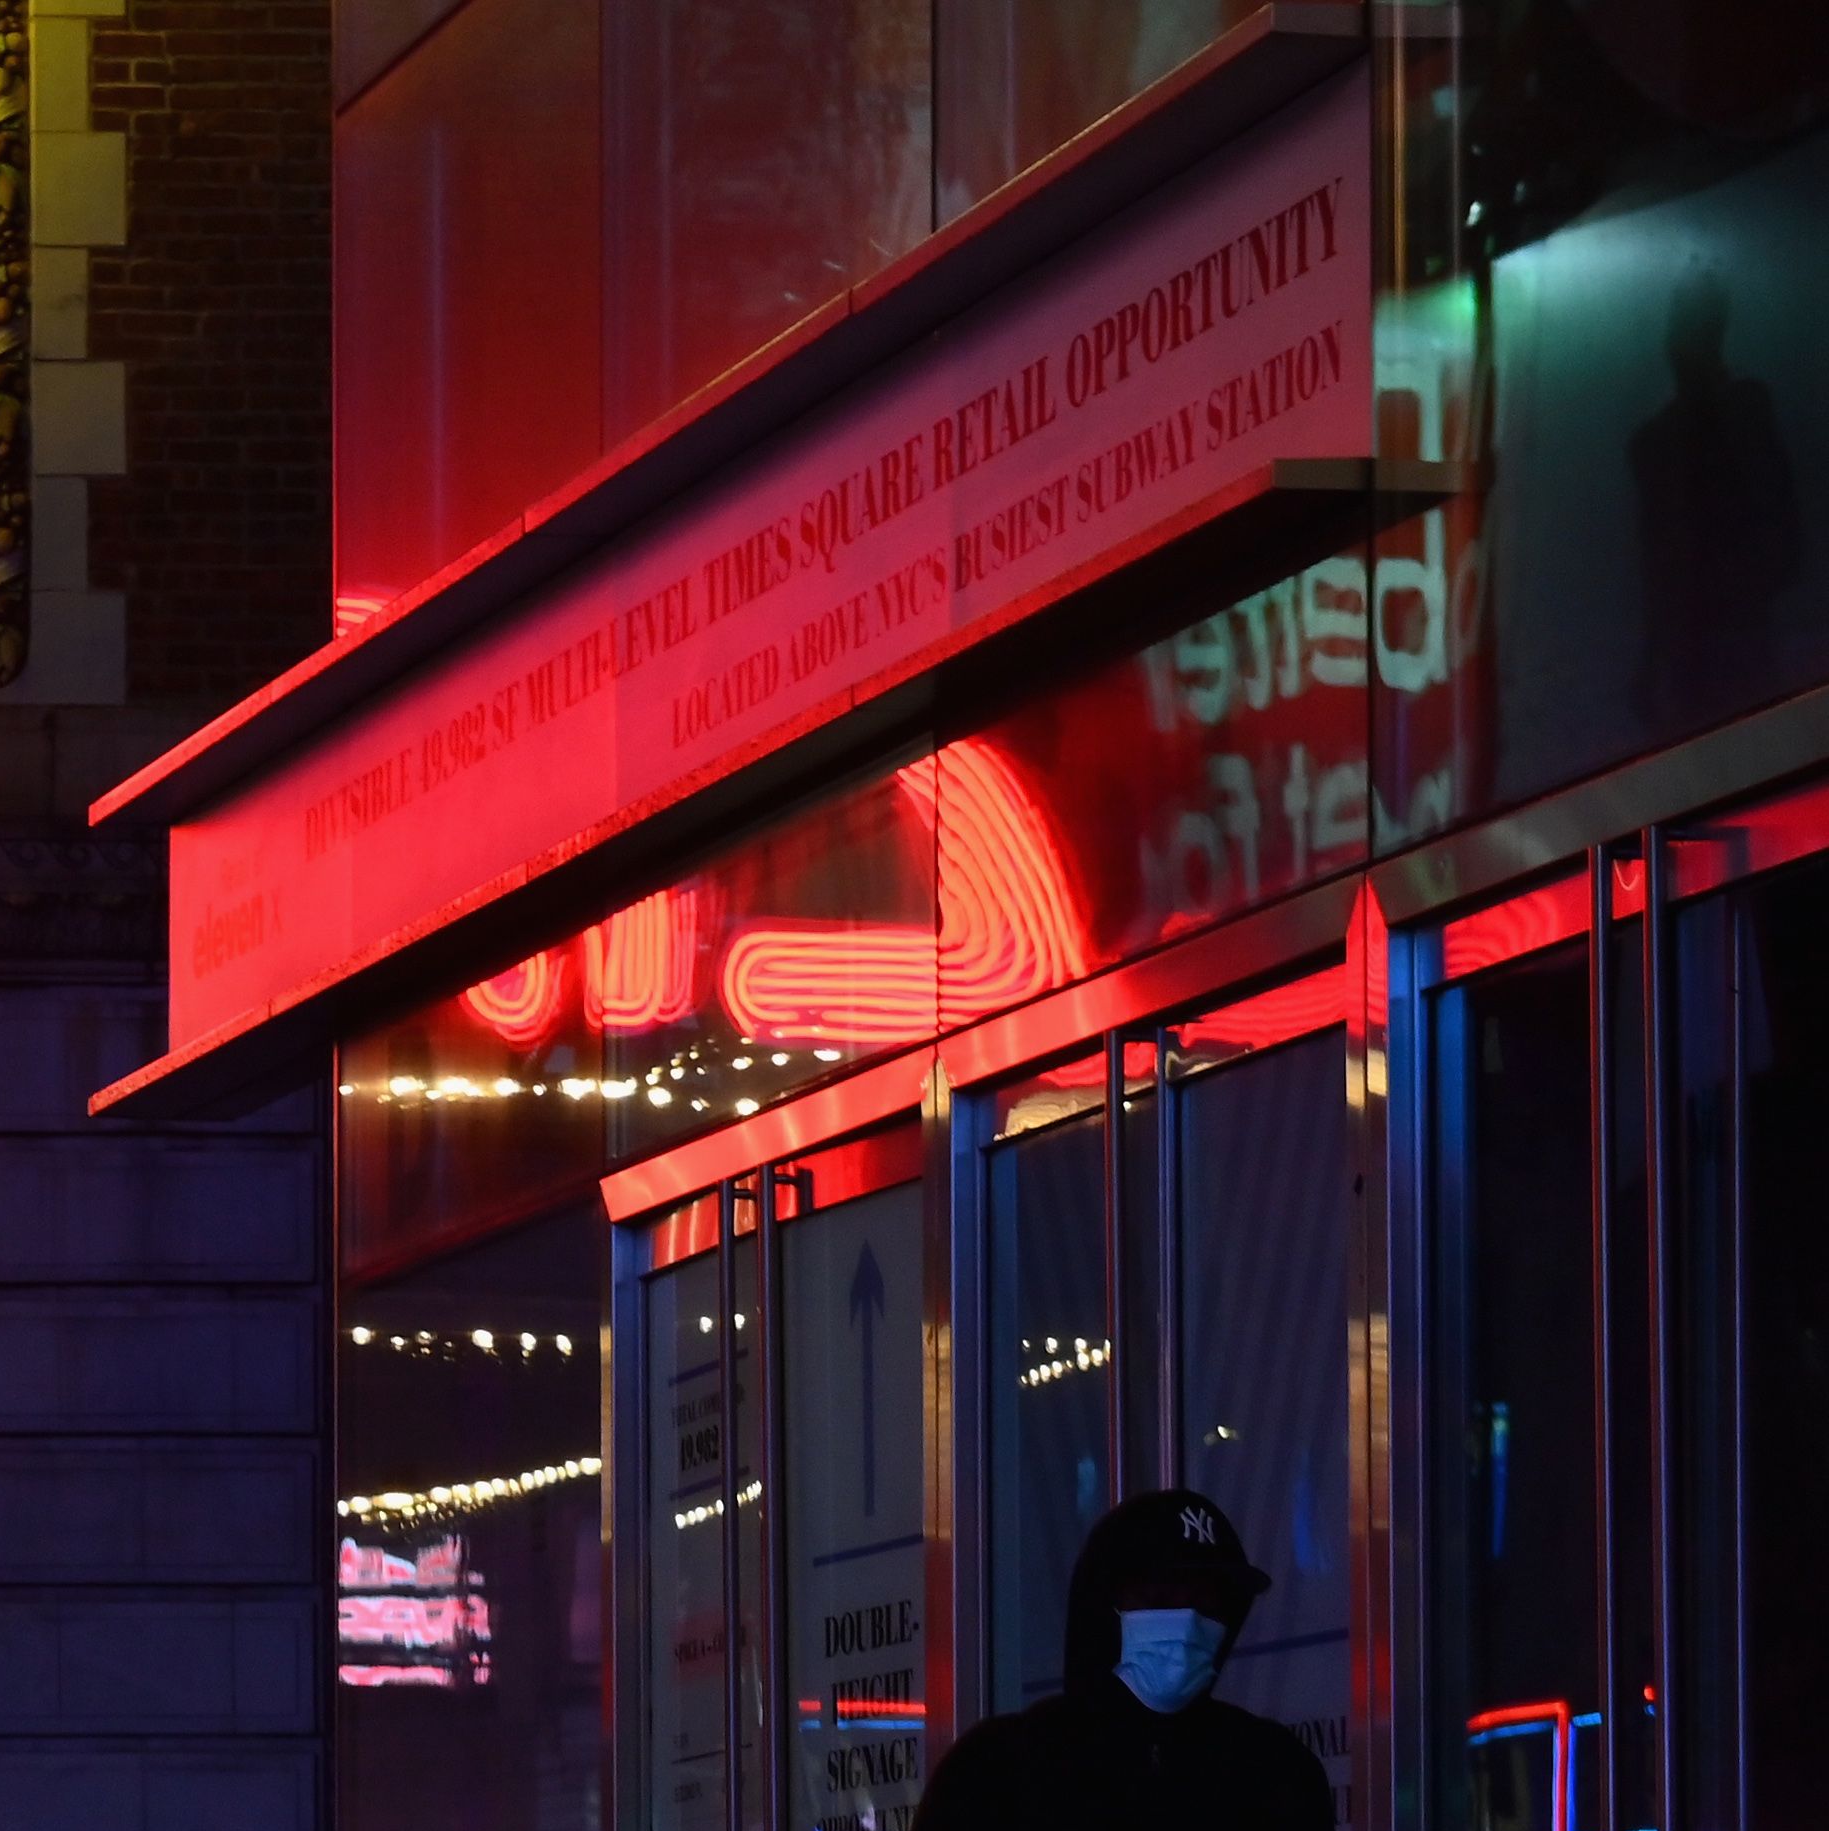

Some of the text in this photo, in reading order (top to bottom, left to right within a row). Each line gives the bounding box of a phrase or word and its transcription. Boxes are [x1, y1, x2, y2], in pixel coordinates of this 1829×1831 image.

[304, 747, 412, 863] DIVISIBLE
[493, 681, 519, 750] SF
[526, 575, 698, 724] MULTI-LEVEL
[702, 516, 792, 626] TIMES
[800, 433, 923, 574] SQUARE
[932, 355, 1057, 492] RETAIL
[1065, 176, 1343, 409] OPPORTUNITY
[672, 319, 1343, 750] LOCATED ABOVE NYC'S BUSIEST SUBWAY STATION
[1179, 1504, 1216, 1545] NY
[825, 1600, 919, 1658] DOUBLE-
[831, 1668, 914, 1727] HEIGHT
[827, 1737, 919, 1793] SIGNAGE
